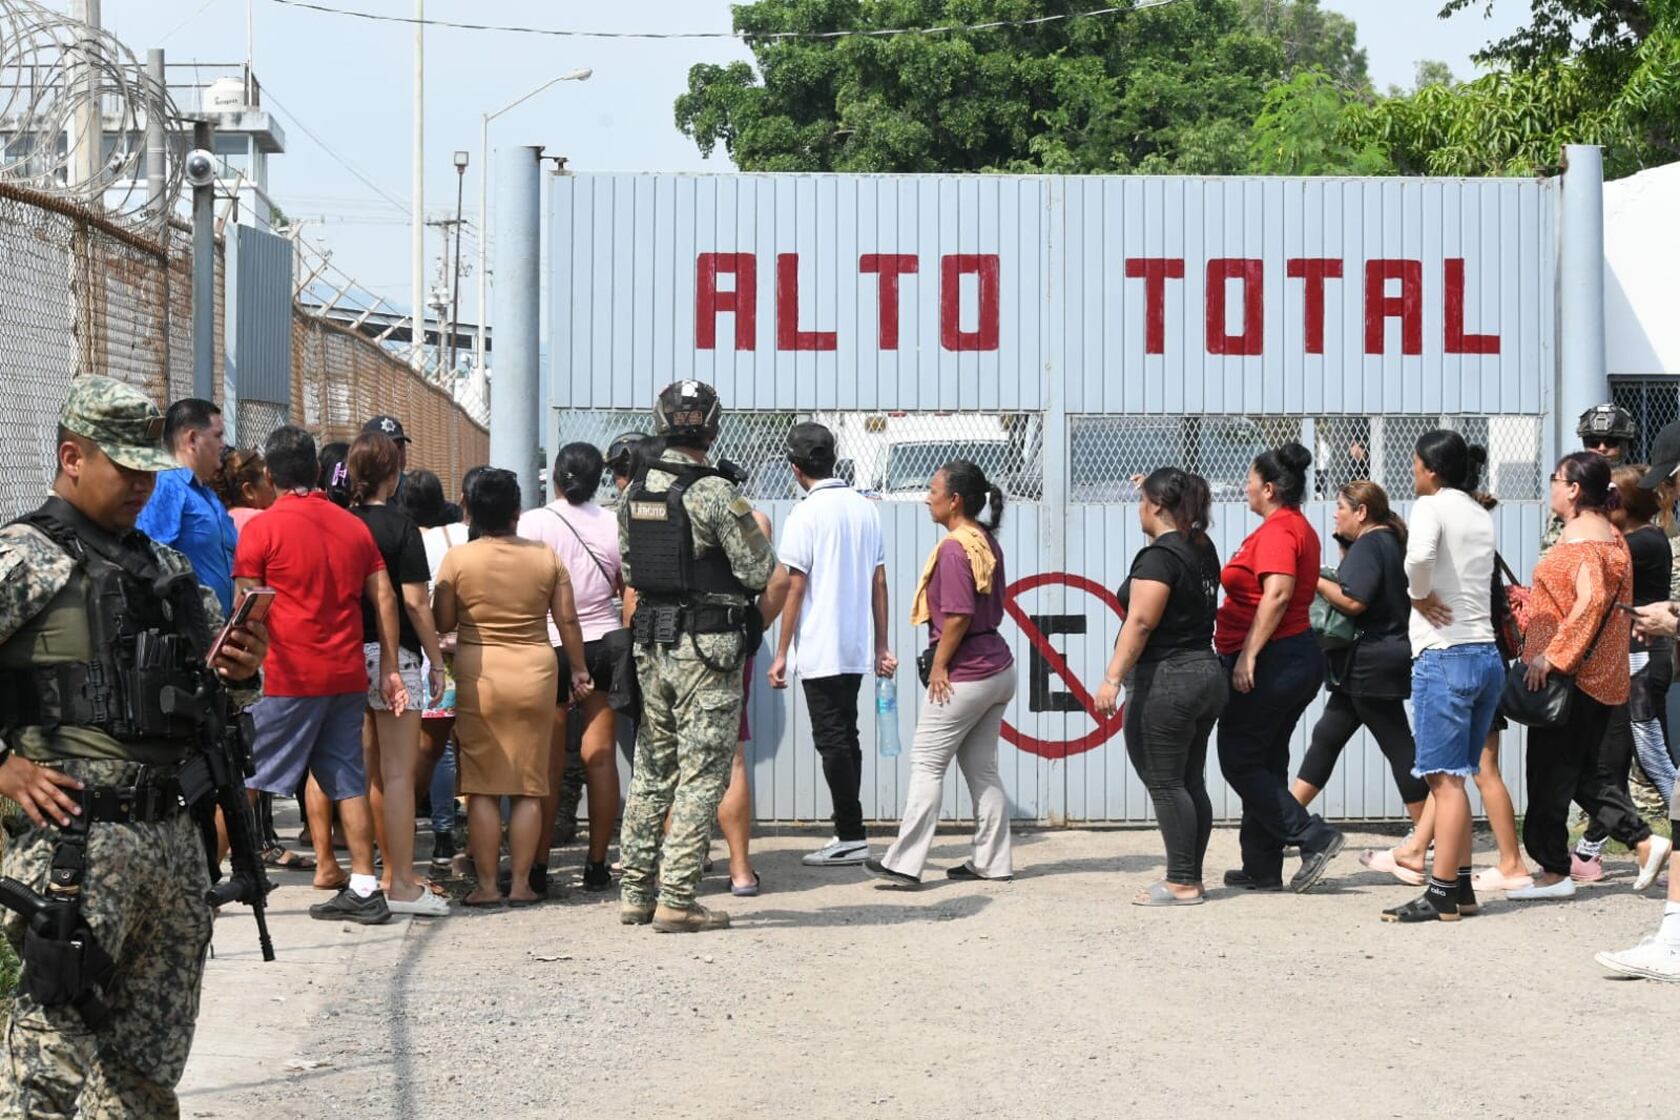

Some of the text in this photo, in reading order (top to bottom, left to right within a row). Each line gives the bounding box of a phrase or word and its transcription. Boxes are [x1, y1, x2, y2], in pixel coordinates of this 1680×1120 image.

[696, 253, 1500, 356] ALTO TOTAL
[1029, 615, 1087, 712] E
